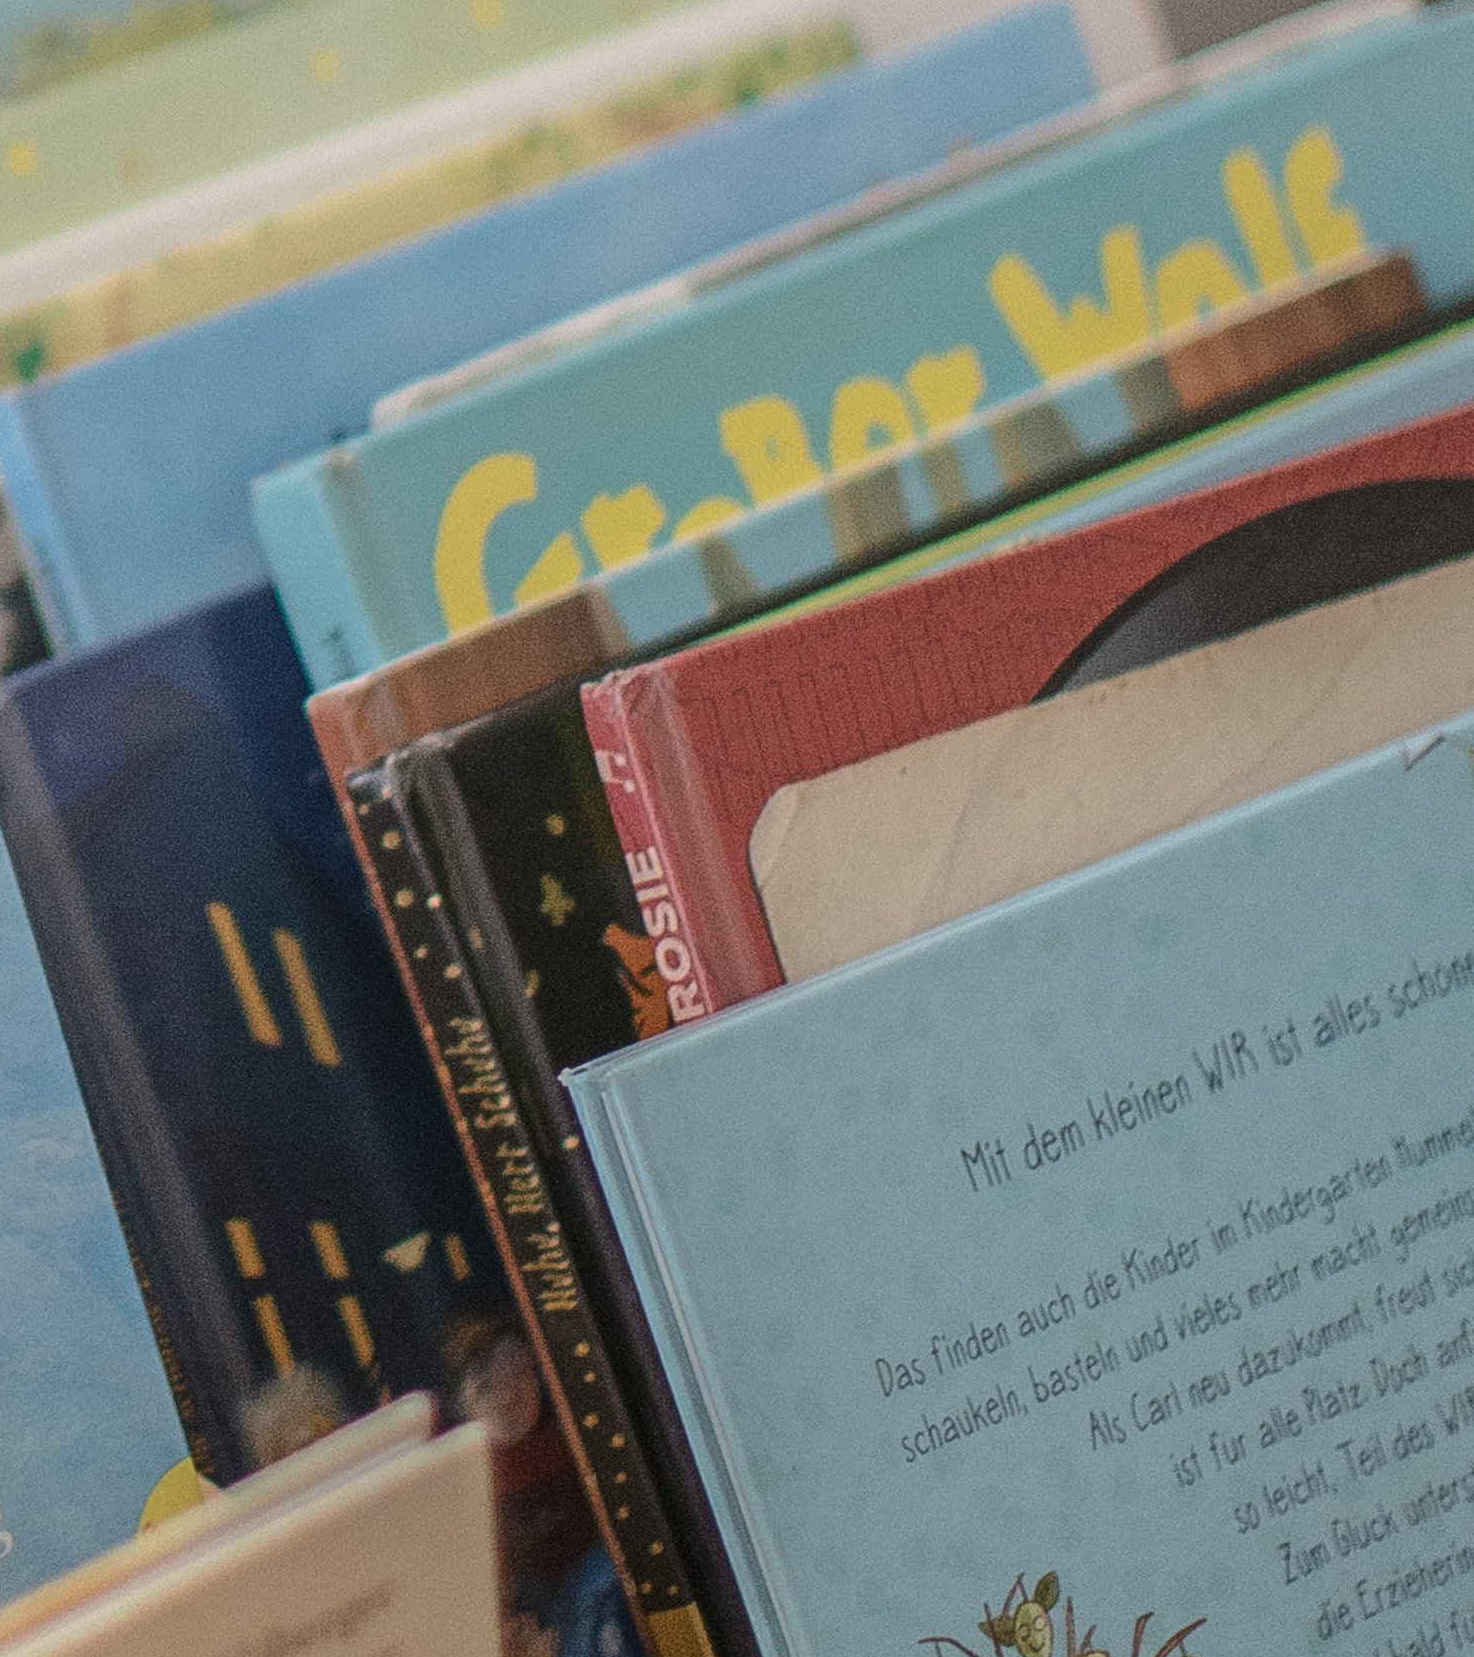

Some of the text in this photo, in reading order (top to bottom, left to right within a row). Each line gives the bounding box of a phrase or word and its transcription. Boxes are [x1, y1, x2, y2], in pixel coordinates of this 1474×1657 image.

[625, 845, 706, 1023] ROSIE
[960, 1135, 1012, 1193] Mit
[1023, 1120, 1085, 1171] dem
[1086, 1070, 1192, 1143] kleinen
[1191, 1030, 1260, 1095] WIR
[1261, 1012, 1305, 1067] ist
[1312, 989, 1382, 1049] alles
[874, 1350, 926, 1398] Das
[930, 1319, 1012, 1377] finden
[1017, 1289, 1077, 1339] auch
[1083, 1265, 1122, 1311] die
[1122, 1236, 1202, 1293] Kinder
[1211, 1219, 1239, 1255] im
[1239, 1153, 1393, 1240] Kindergarten
[901, 1382, 1030, 1464] schaukeln,
[1027, 1345, 1121, 1407] basteln
[1125, 1310, 1170, 1365] und
[1173, 1291, 1243, 1341] vieles
[1087, 1406, 1129, 1452] Als
[1129, 1379, 1183, 1435] Carl
[1186, 1367, 1233, 1406] neu
